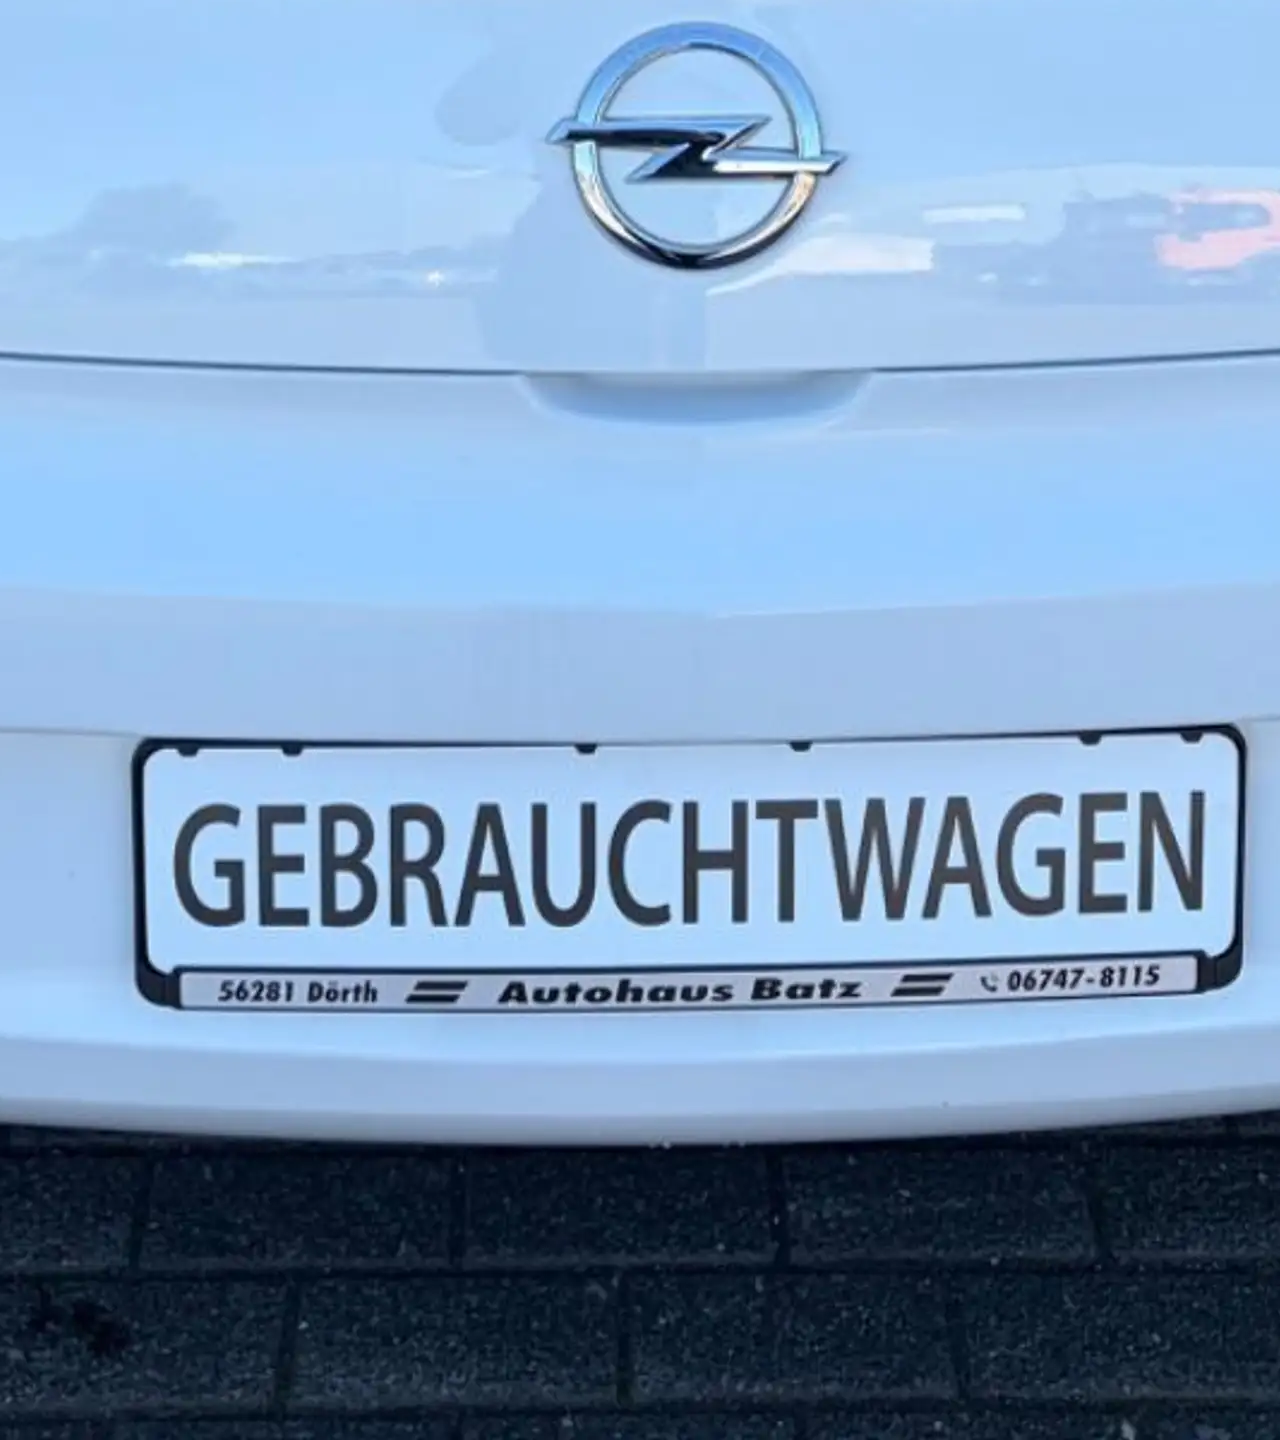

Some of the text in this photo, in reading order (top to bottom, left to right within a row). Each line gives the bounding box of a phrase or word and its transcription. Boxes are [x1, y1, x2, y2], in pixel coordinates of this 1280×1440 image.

[172, 790, 1206, 928] GEBRAUCHTWAGEN
[218, 964, 1161, 1005] 56281 Dörth Autohaus Batz 06747-8115
